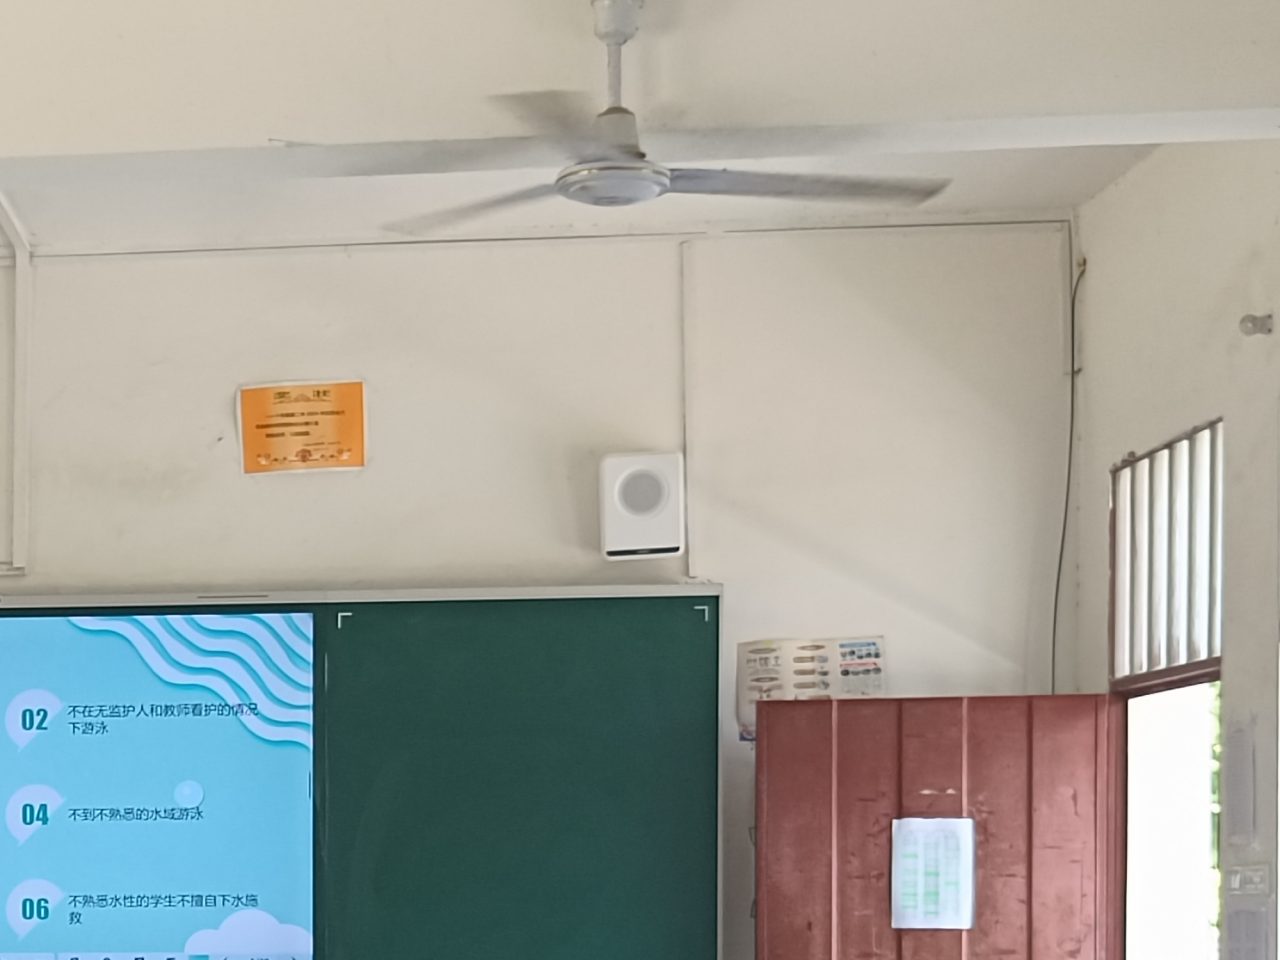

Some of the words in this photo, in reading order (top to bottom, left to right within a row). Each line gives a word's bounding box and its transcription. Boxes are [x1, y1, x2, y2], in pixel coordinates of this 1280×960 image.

[67, 702, 259, 719] 不在无监护人和教师看护的情况
[20, 708, 49, 731] 02
[68, 721, 109, 736] 下游泳
[21, 803, 49, 826] 04
[67, 806, 204, 822] 不到不熟悉的水域游泳
[21, 898, 49, 921] 06
[68, 894, 259, 909] 不熟悉水性的学生不擅自下水施
[68, 910, 83, 926] 救
